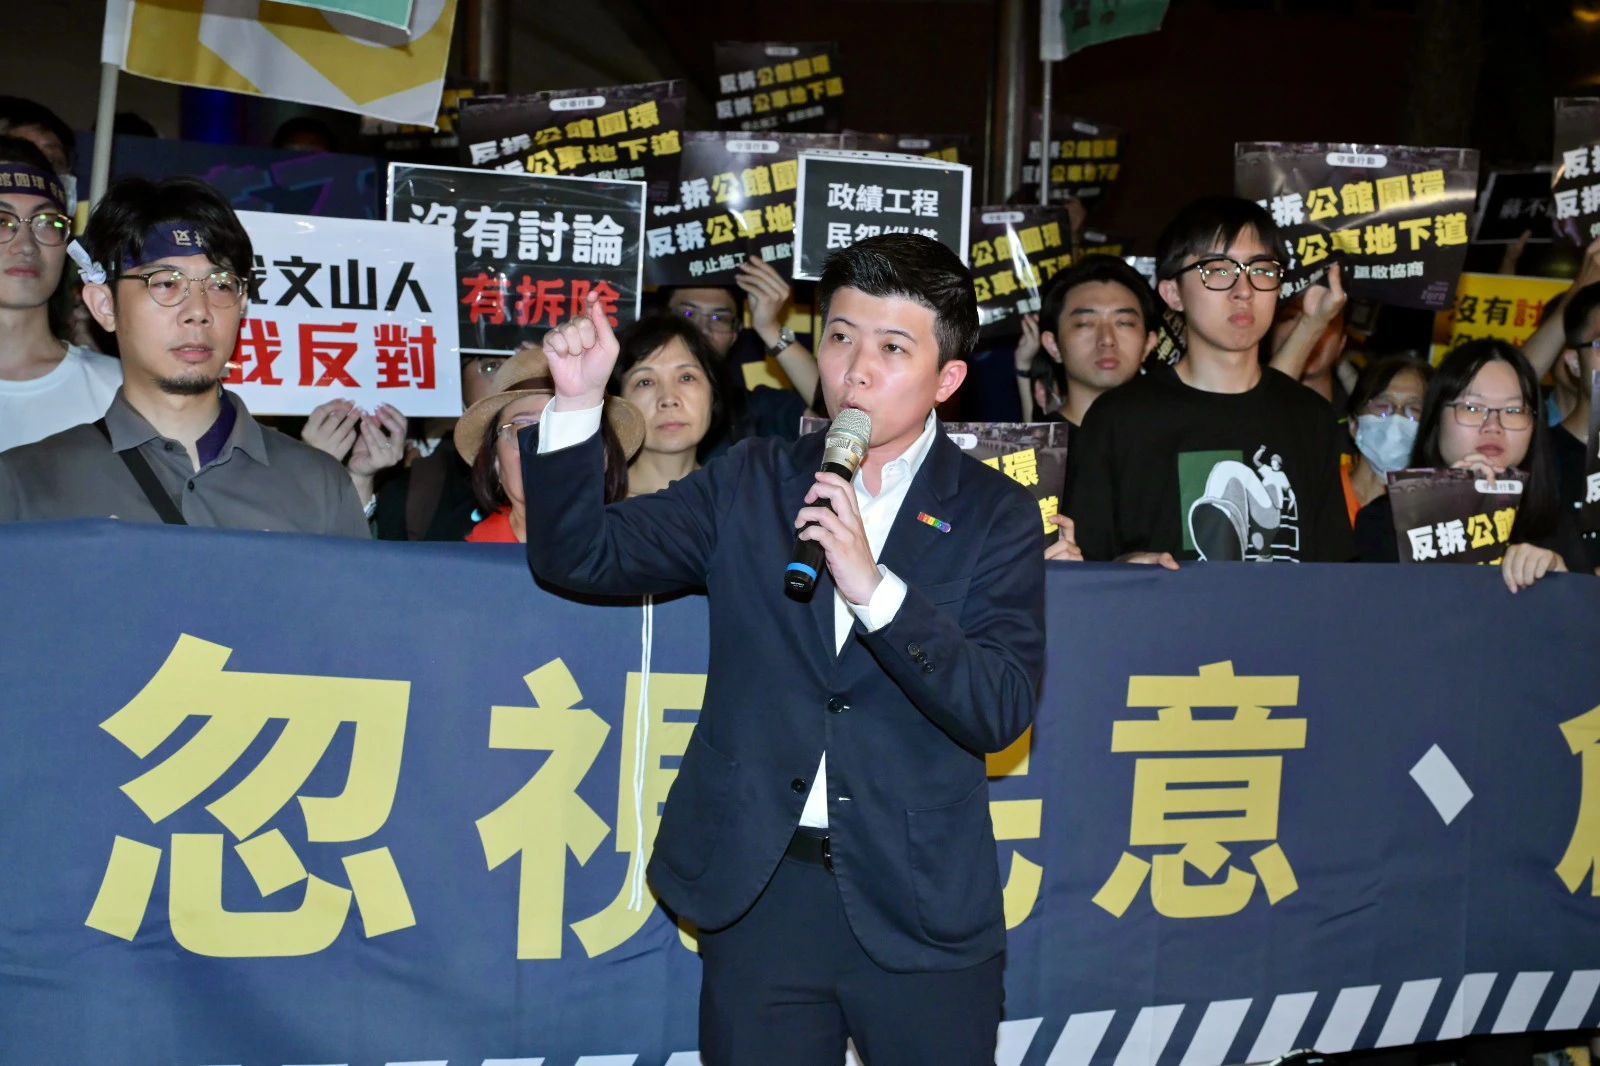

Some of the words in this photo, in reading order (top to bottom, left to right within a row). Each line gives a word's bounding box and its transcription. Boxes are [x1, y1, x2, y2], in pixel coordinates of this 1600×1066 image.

[654, 160, 797, 217] 拆公館圓
[827, 182, 939, 217] 政績工程
[1257, 169, 1446, 228] 拆公館圓環
[646, 201, 797, 259] 反拆公車地
[760, 241, 795, 262] 重啟
[1284, 212, 1469, 270] 公車地下道
[460, 271, 622, 329] 有拆除
[220, 318, 438, 390] 我反對
